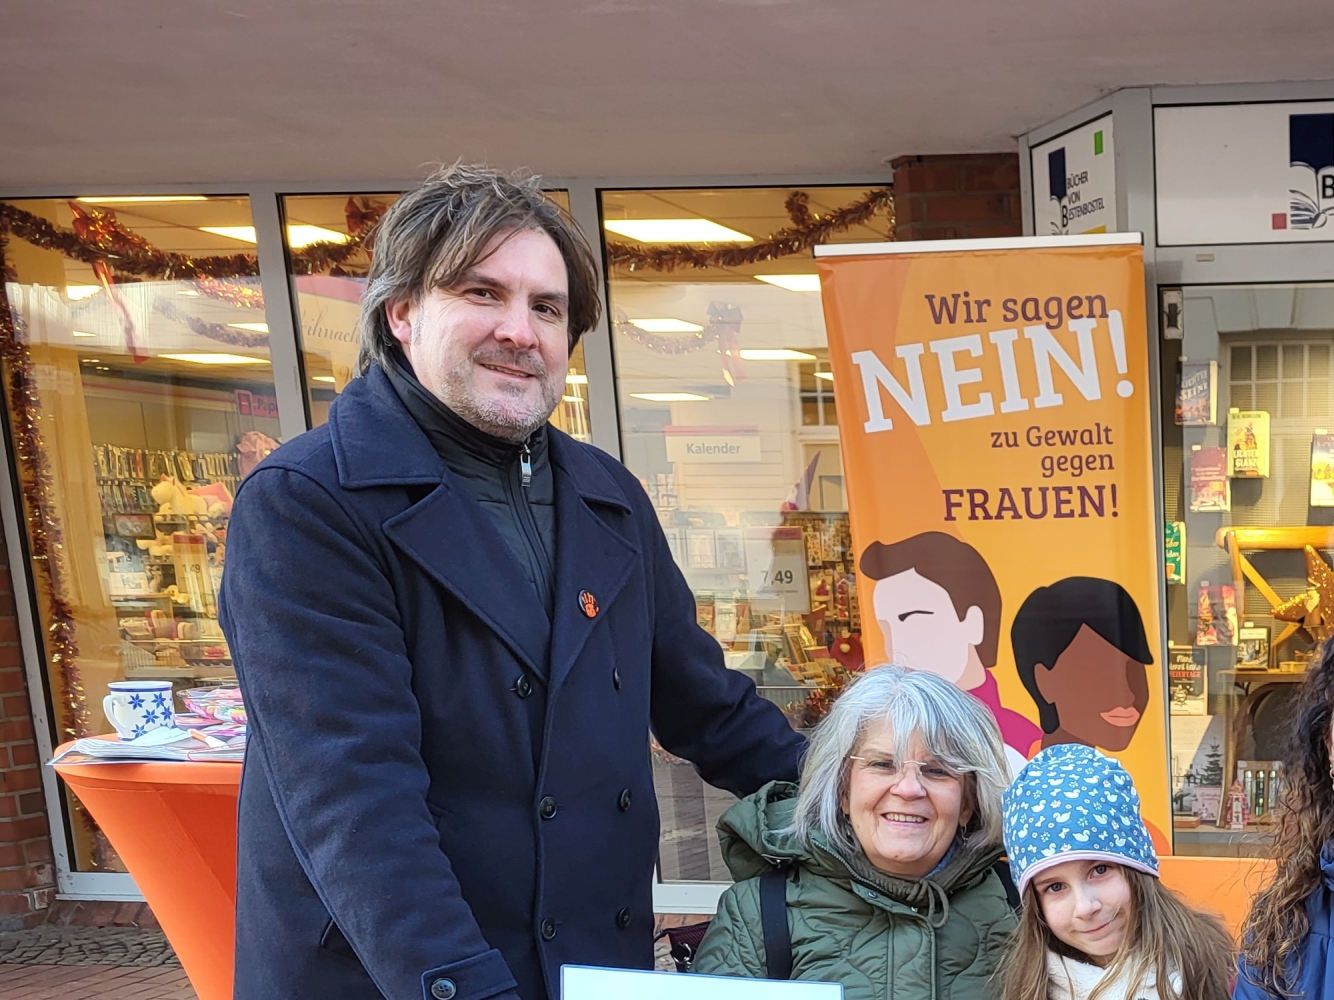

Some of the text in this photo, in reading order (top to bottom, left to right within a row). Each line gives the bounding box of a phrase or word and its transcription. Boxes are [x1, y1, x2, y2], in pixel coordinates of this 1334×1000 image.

[1067, 170, 1089, 190] BÜCHER
[1067, 190, 1081, 206] VON
[924, 290, 1110, 329] Wir sagen
[851, 309, 1134, 434] NEIN!
[257, 397, 276, 415] Pap
[990, 422, 1114, 448] zu Gewalt
[686, 442, 741, 454] Kalender
[1040, 453, 1115, 478] gegen
[942, 483, 1119, 522] FRAUEN!
[760, 569, 794, 586] 7,49
